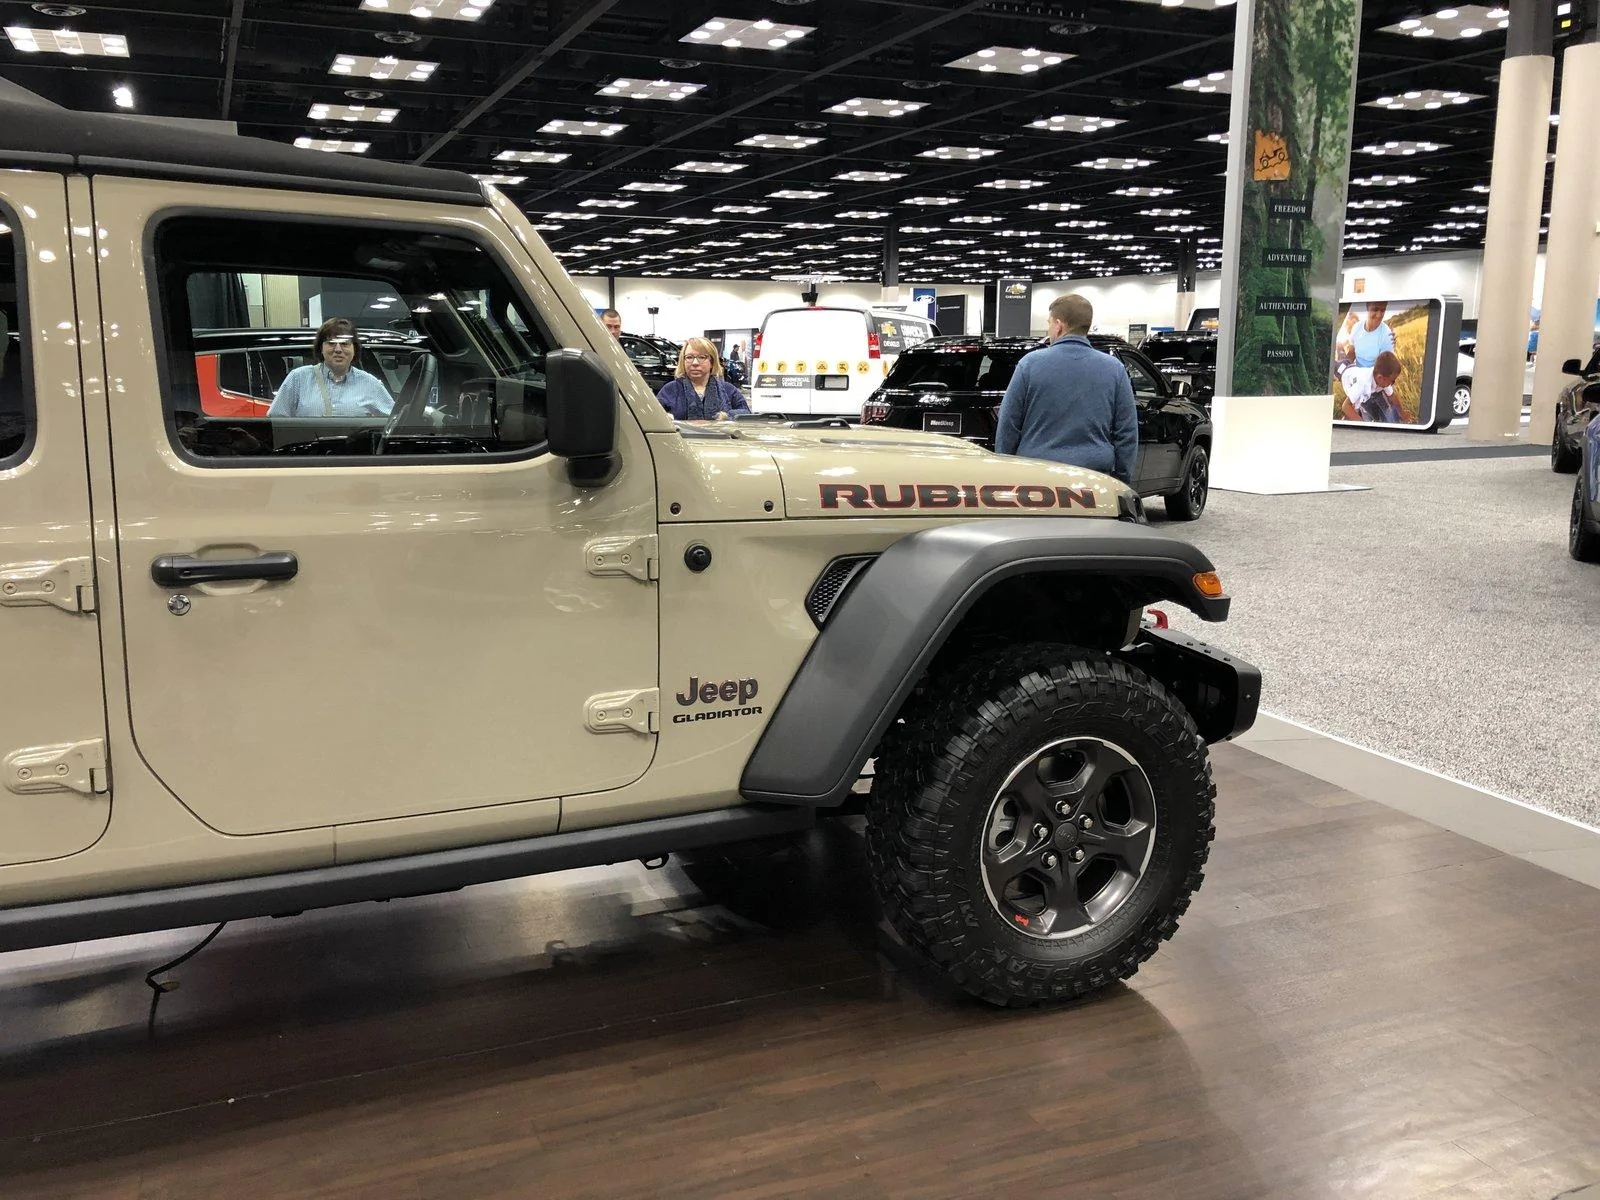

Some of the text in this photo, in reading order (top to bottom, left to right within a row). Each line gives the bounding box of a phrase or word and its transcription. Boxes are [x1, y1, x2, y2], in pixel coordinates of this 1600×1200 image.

[1273, 204, 1307, 214] FREEDOM
[1266, 253, 1307, 263] ADVENTURE
[1258, 301, 1308, 311] AUTHENTICITY
[1266, 349, 1294, 358] PASSION
[818, 483, 1098, 510] RUBICON
[676, 676, 759, 706] Jeep
[672, 706, 763, 724] GLADIATOR
